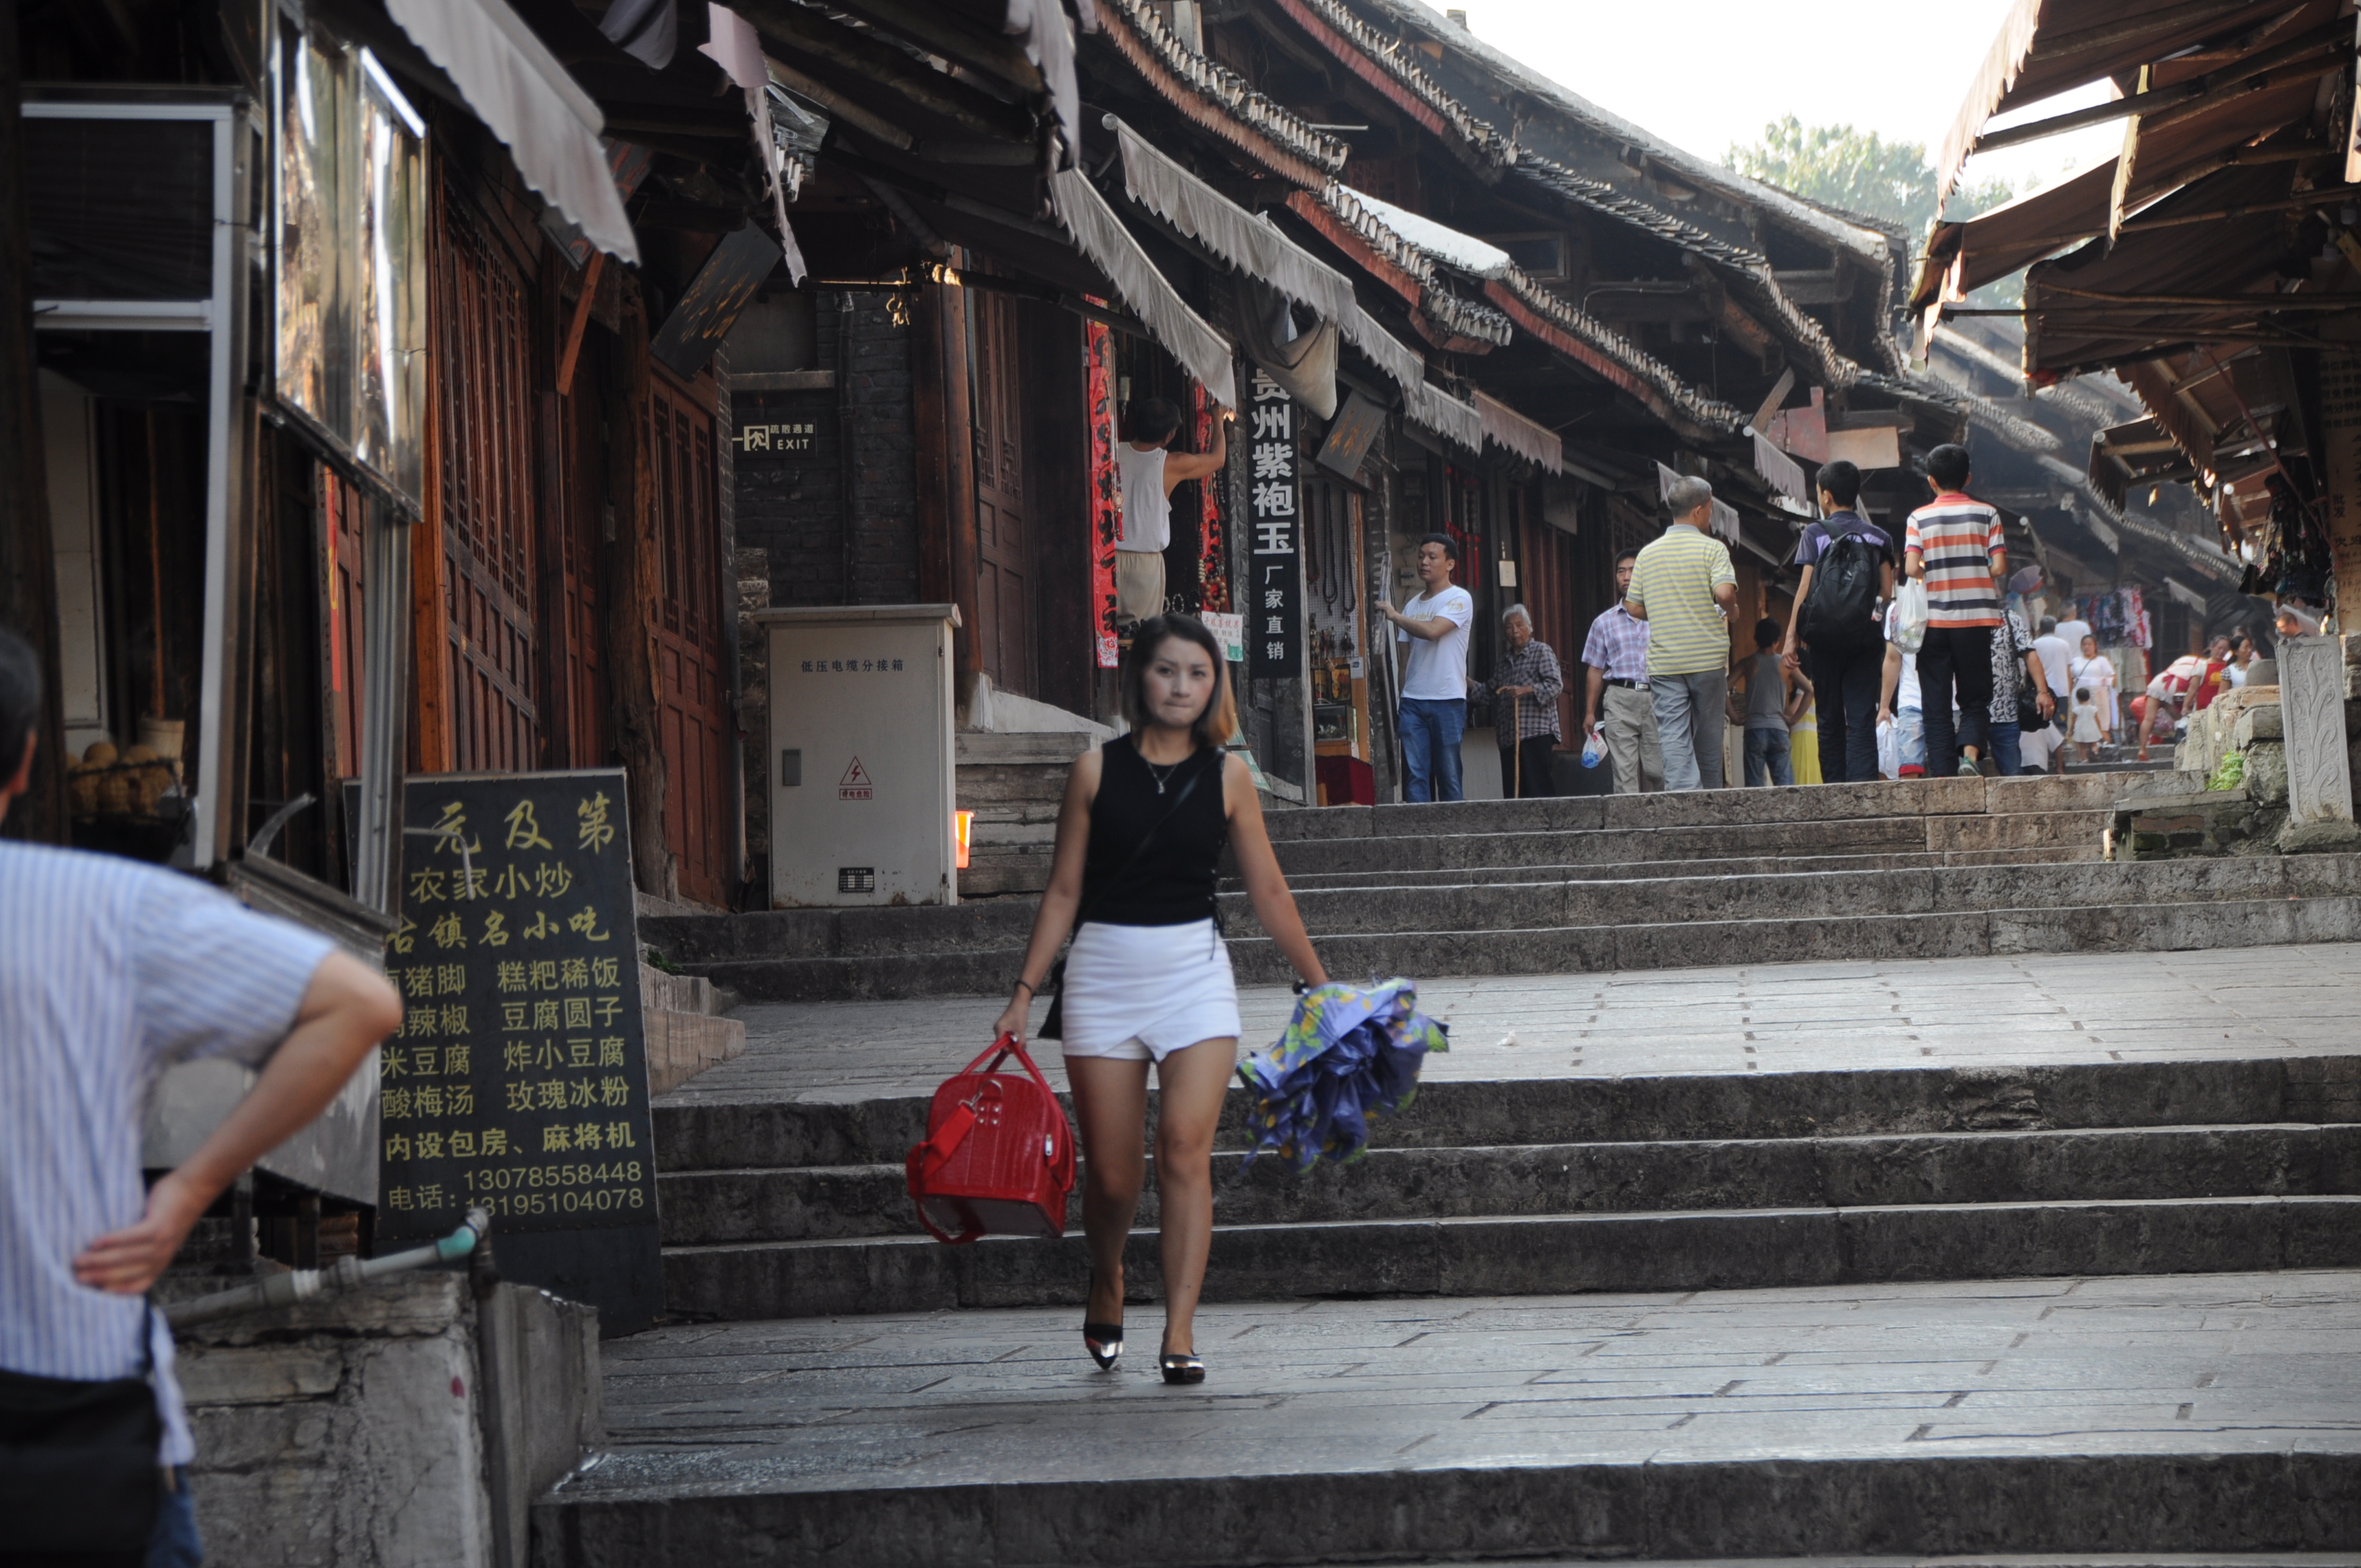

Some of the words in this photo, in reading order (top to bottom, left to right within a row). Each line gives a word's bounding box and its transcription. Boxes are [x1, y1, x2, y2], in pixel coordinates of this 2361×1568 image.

[770, 424, 814, 435] 疏散通道
[777, 439, 809, 450] EXIT
[1251, 368, 1296, 556] 贵州紫袍玉
[1264, 565, 1285, 661] 厂家直销
[800, 658, 904, 674] 低压电缆分接箱
[410, 861, 573, 904] 农家小炒
[391, 1003, 471, 1039] 辣椒
[501, 996, 623, 1031] 豆腐圆子
[380, 1044, 471, 1078] 米豆腐
[504, 1036, 625, 1072] 炸小豆腐
[382, 1084, 474, 1119] 酸梅汤
[506, 1075, 629, 1112] 玫瑰冰粉
[464, 1161, 642, 1191] 13078558448
[465, 1188, 644, 1217] 13195104078
